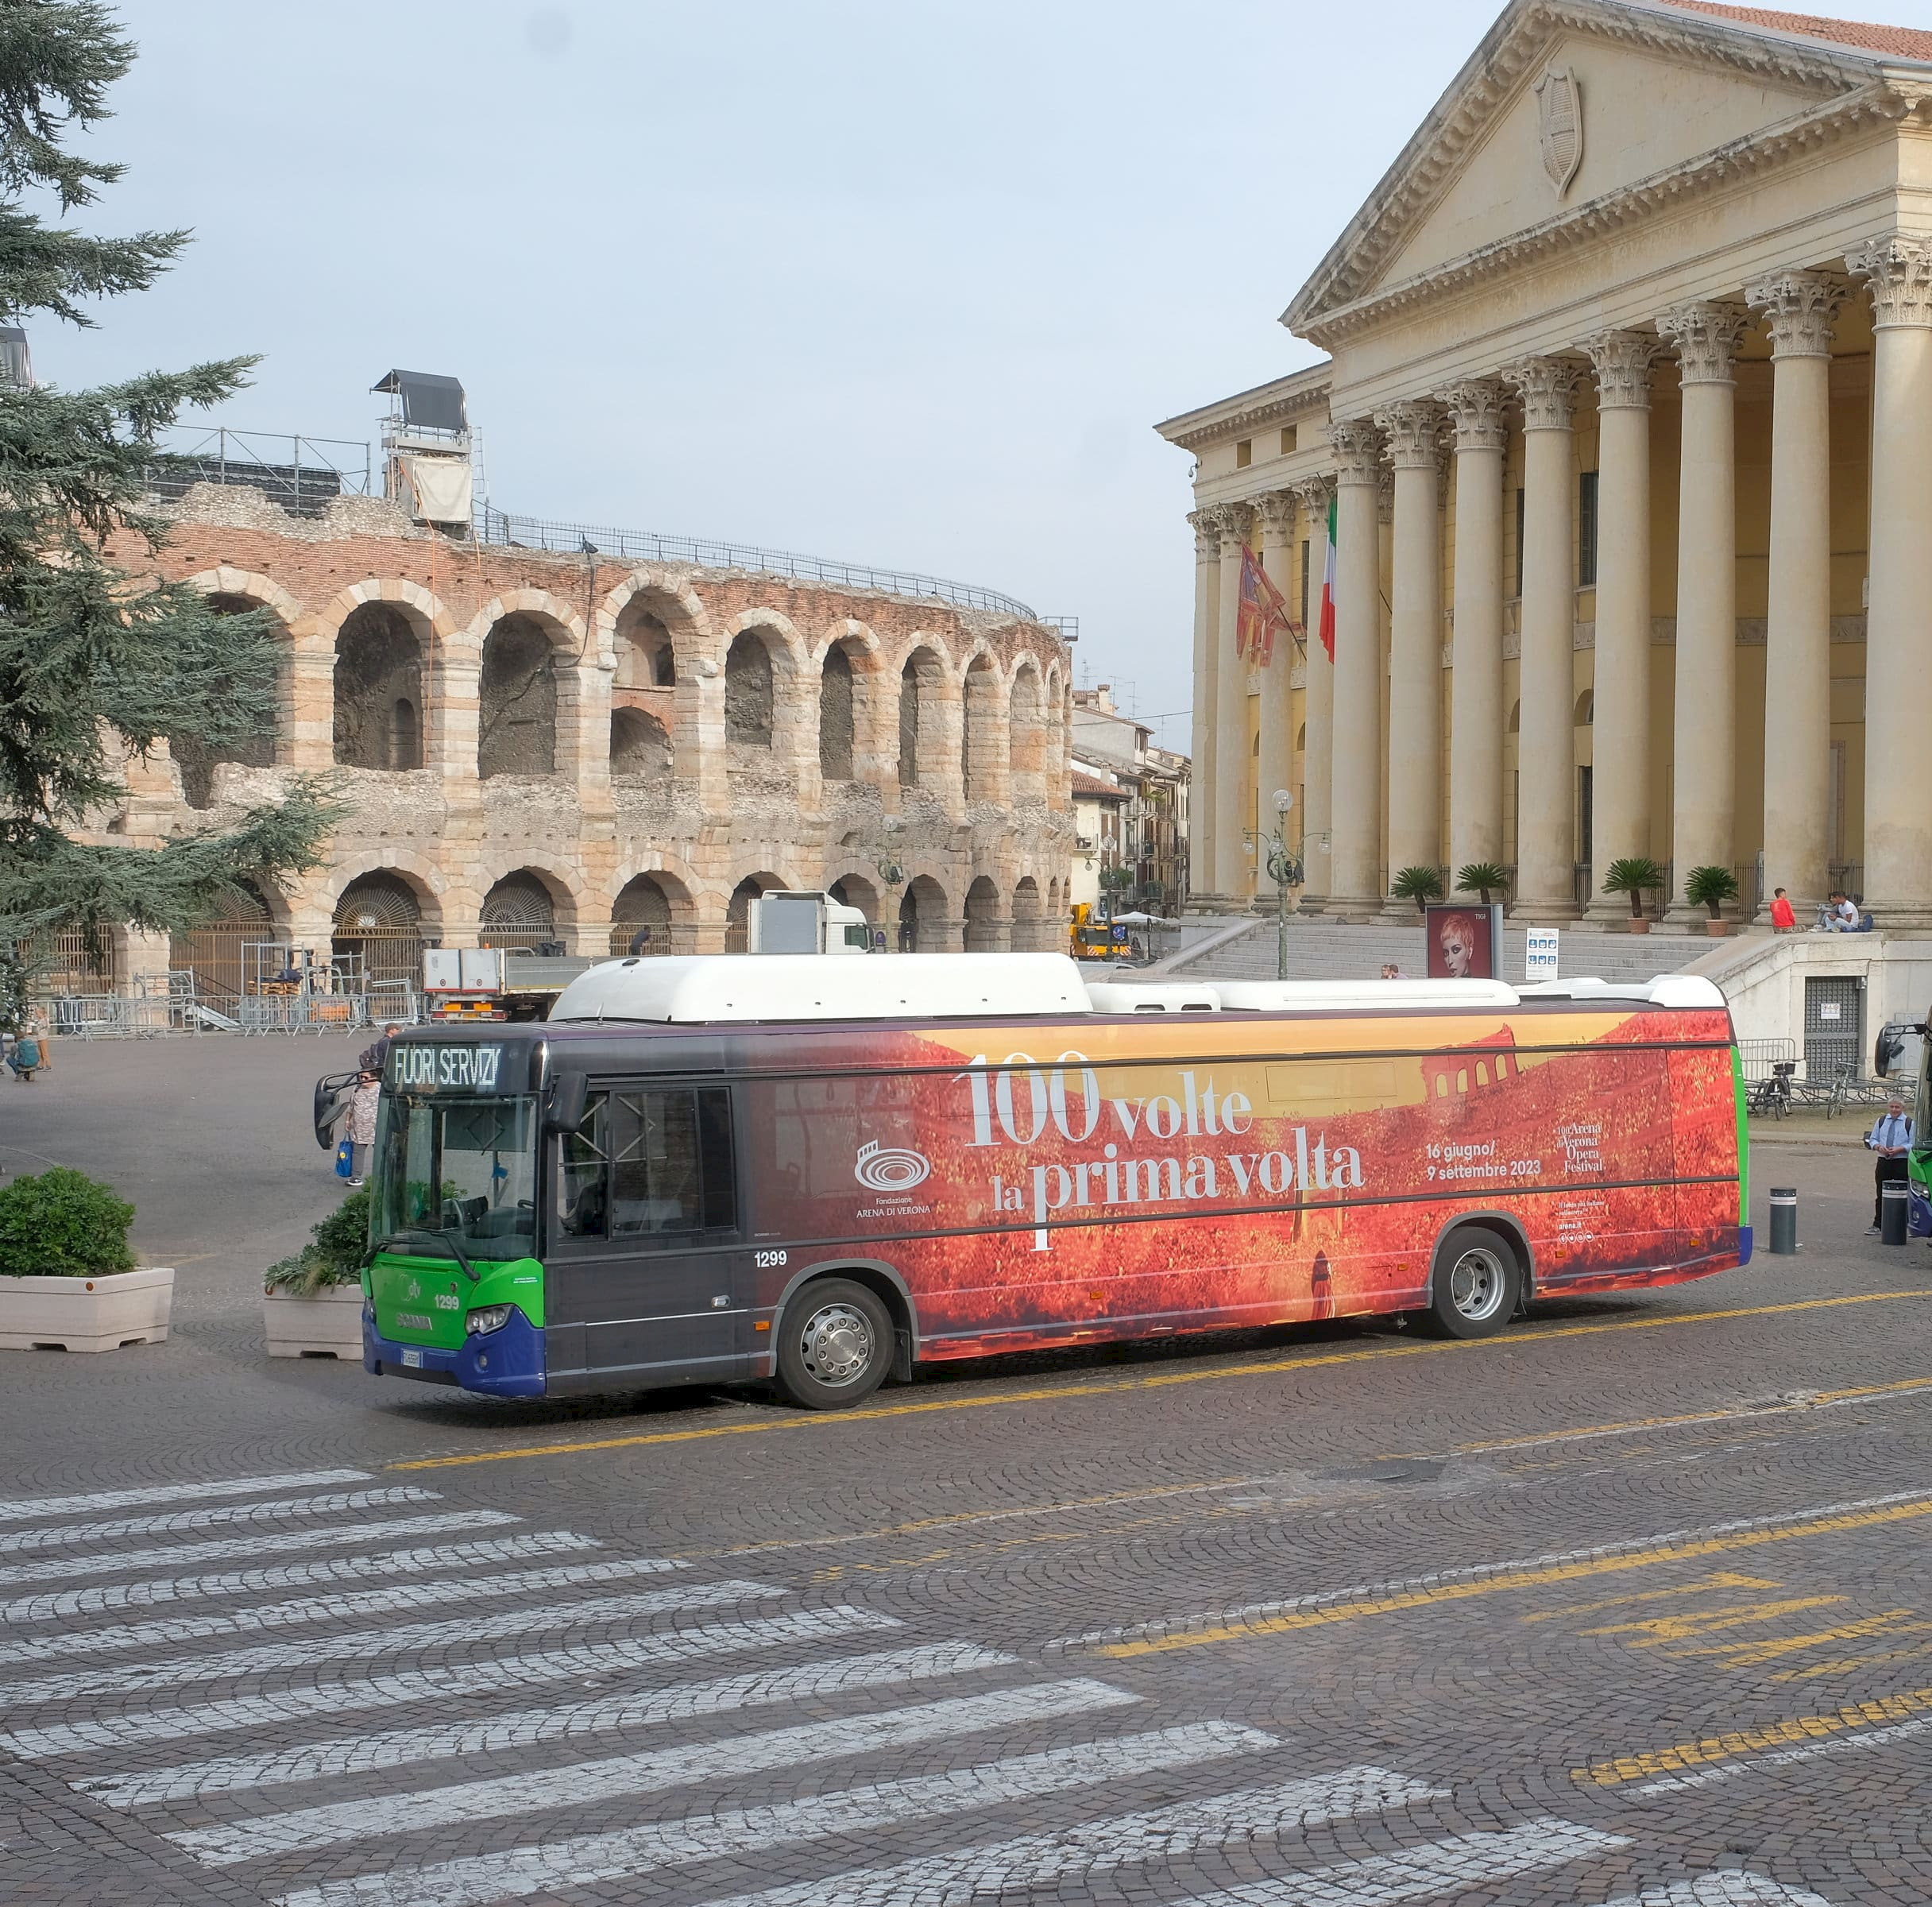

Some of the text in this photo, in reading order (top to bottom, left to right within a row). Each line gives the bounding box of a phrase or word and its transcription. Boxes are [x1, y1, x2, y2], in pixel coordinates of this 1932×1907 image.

[395, 1048, 435, 1085] FUORI
[952, 1050, 1254, 1147] 100 volte
[1571, 1122, 1602, 1135] Arena
[1426, 1139, 1495, 1163] 16 giugno/
[1563, 1135, 1598, 1149] Verona
[1567, 1144, 1599, 1163] Opera
[1427, 1159, 1541, 1181] 9 settembre 2023
[1564, 1159, 1603, 1173] Festival
[992, 1125, 1366, 1252] la prima volta
[856, 1209, 885, 1218] ARENA
[897, 1205, 931, 1215] VERONA
[1559, 1221, 1582, 1230] arena.it
[754, 1250, 787, 1268] 1299
[434, 1294, 459, 1310] 1299
